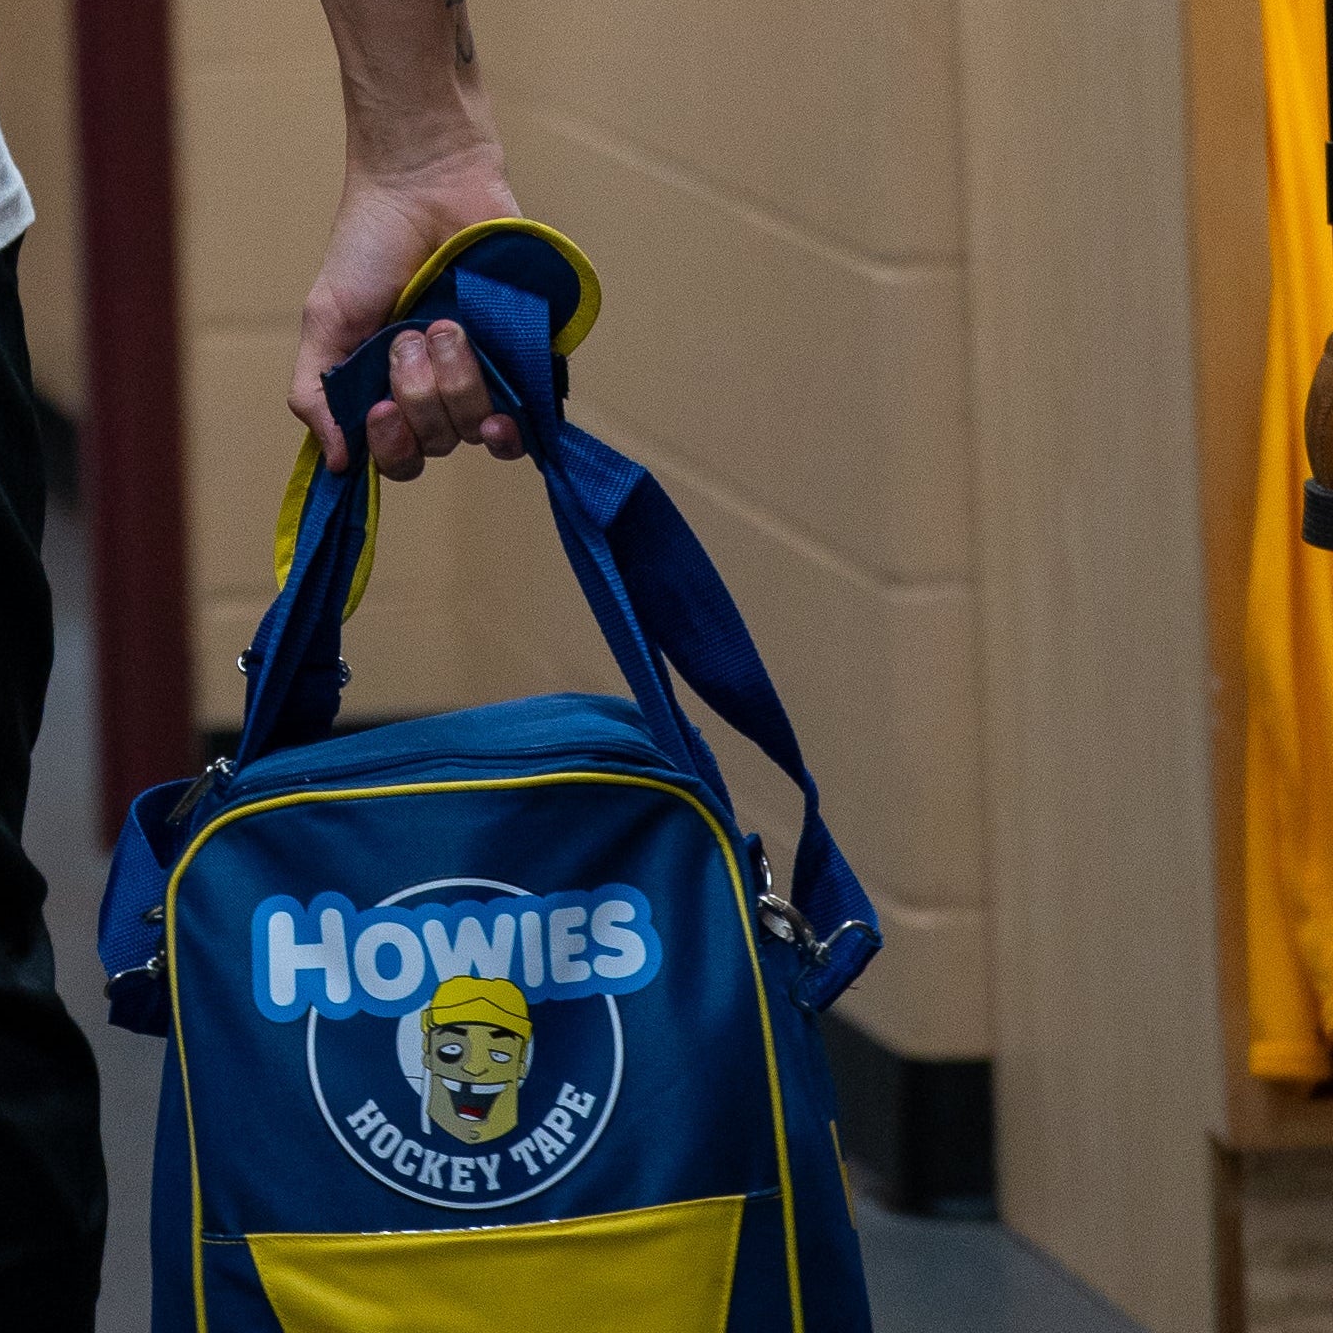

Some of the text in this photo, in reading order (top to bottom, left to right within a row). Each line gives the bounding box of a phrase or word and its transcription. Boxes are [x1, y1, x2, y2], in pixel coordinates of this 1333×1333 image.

[268, 899, 647, 1006] HOWIES
[345, 1082, 596, 1192] HOCKEY TAPE
